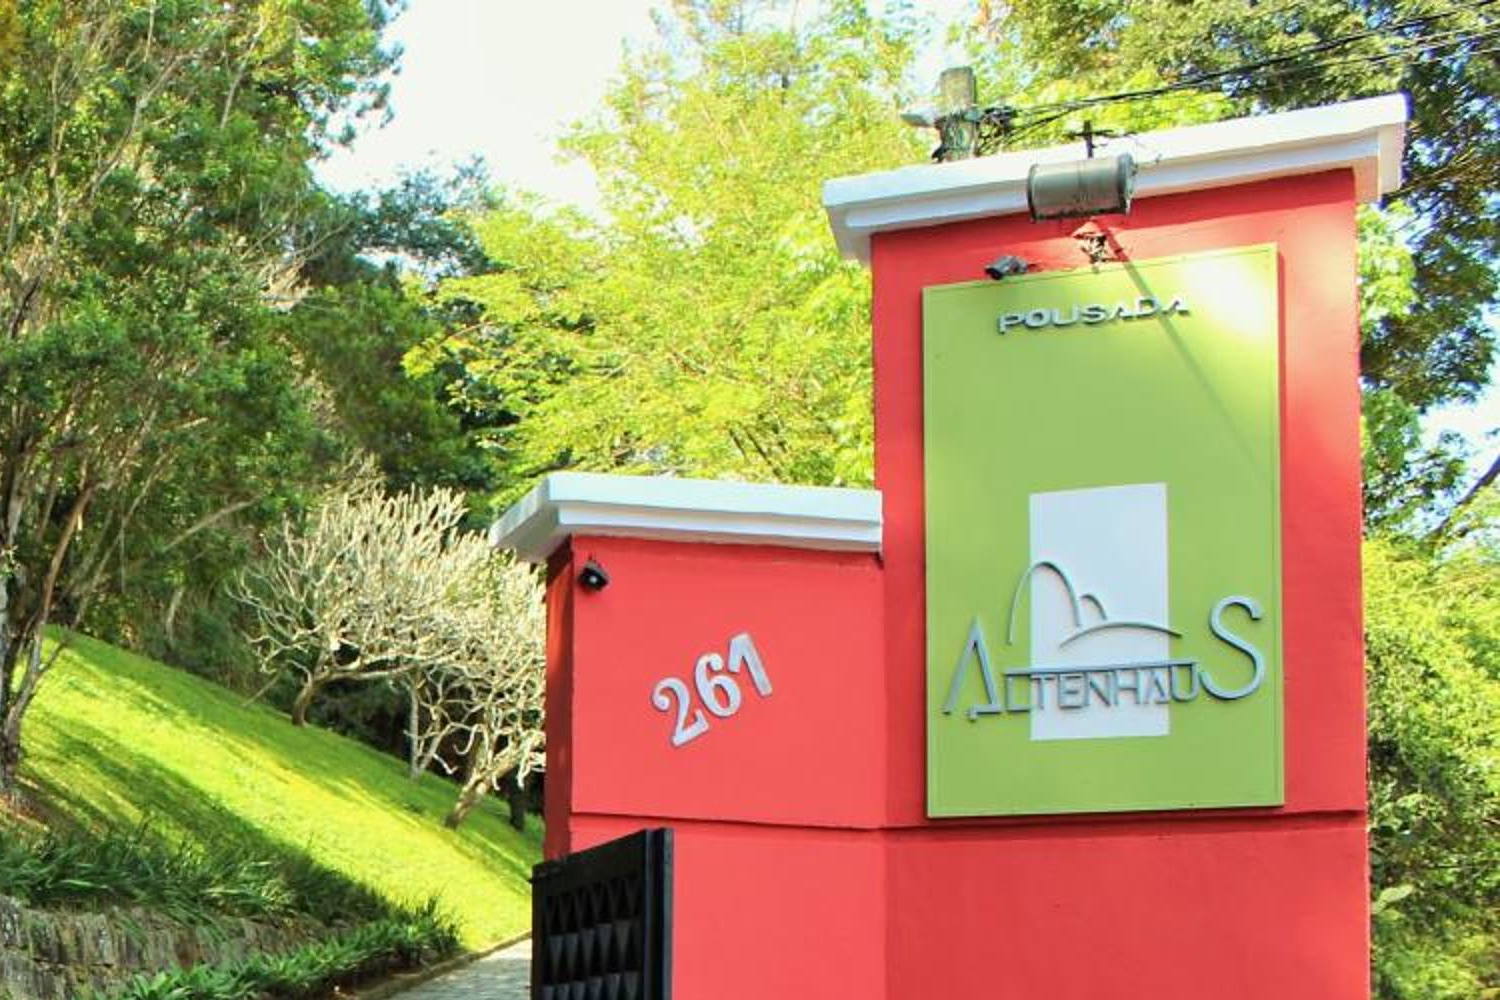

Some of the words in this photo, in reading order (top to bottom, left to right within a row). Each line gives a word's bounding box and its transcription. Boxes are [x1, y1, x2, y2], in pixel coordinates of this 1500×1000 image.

[997, 295, 1190, 334] POUSADA
[652, 632, 773, 747] 261
[942, 596, 1264, 721] ALTENHAUS
